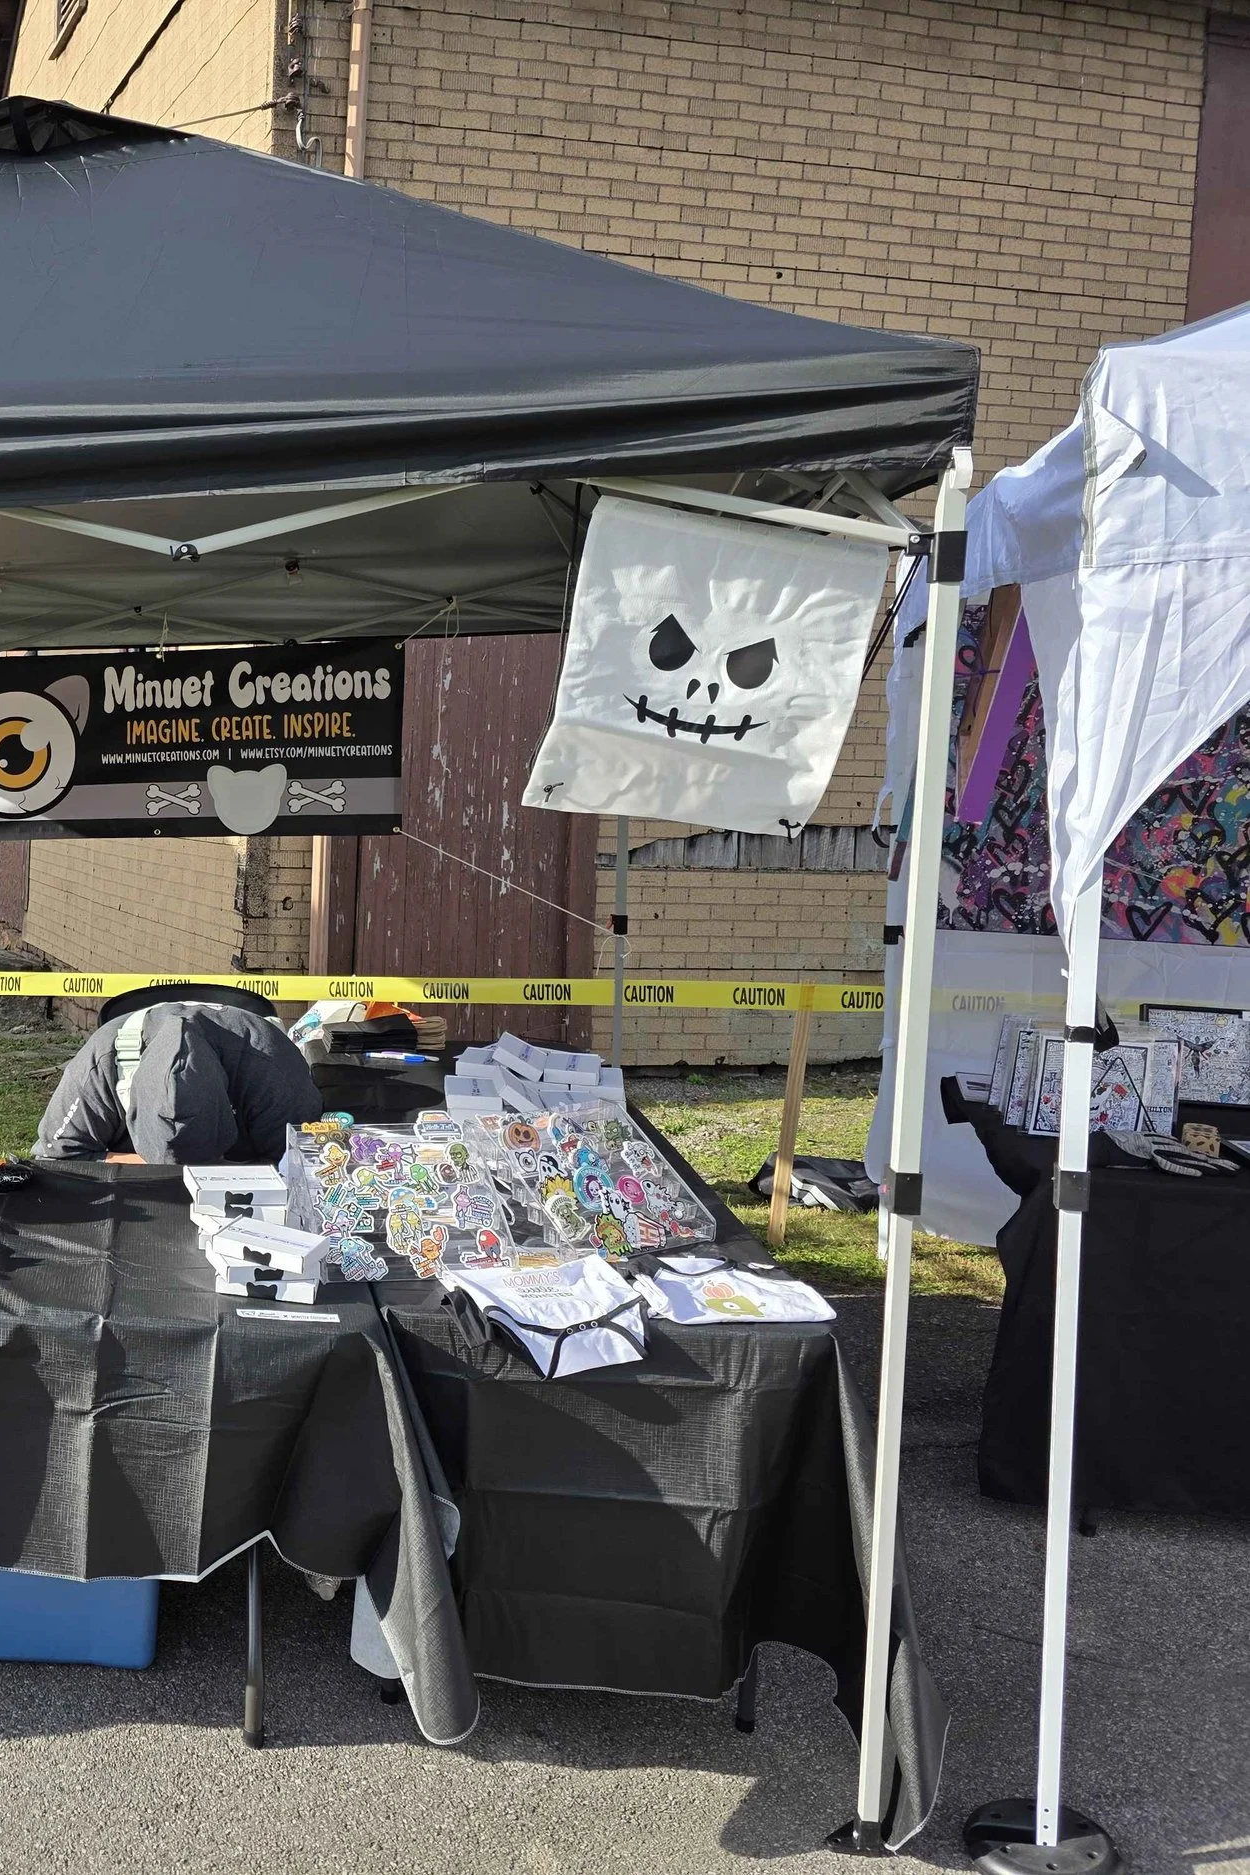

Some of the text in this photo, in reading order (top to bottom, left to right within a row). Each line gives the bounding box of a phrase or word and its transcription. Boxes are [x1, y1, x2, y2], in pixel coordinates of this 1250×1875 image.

[104, 661, 391, 713] Minuet Creations
[127, 712, 355, 744] IMAGINE. CREATE. INSPIRE.
[102, 749, 219, 764] WWW.MINUETCREATIONS.COM
[241, 745, 392, 758] WWW.ETSY.COM/MINUETYCREATIONS
[63, 977, 103, 993] CAUTION
[328, 981, 374, 998] CAUTION
[422, 982, 469, 1000] CAUTION
[522, 983, 572, 1001] CAUTION
[623, 985, 675, 1003] CAUTION
[732, 986, 785, 1006] CAUTION
[840, 990, 884, 1010] CAUTIO
[503, 1271, 560, 1287] MOMMY'S
